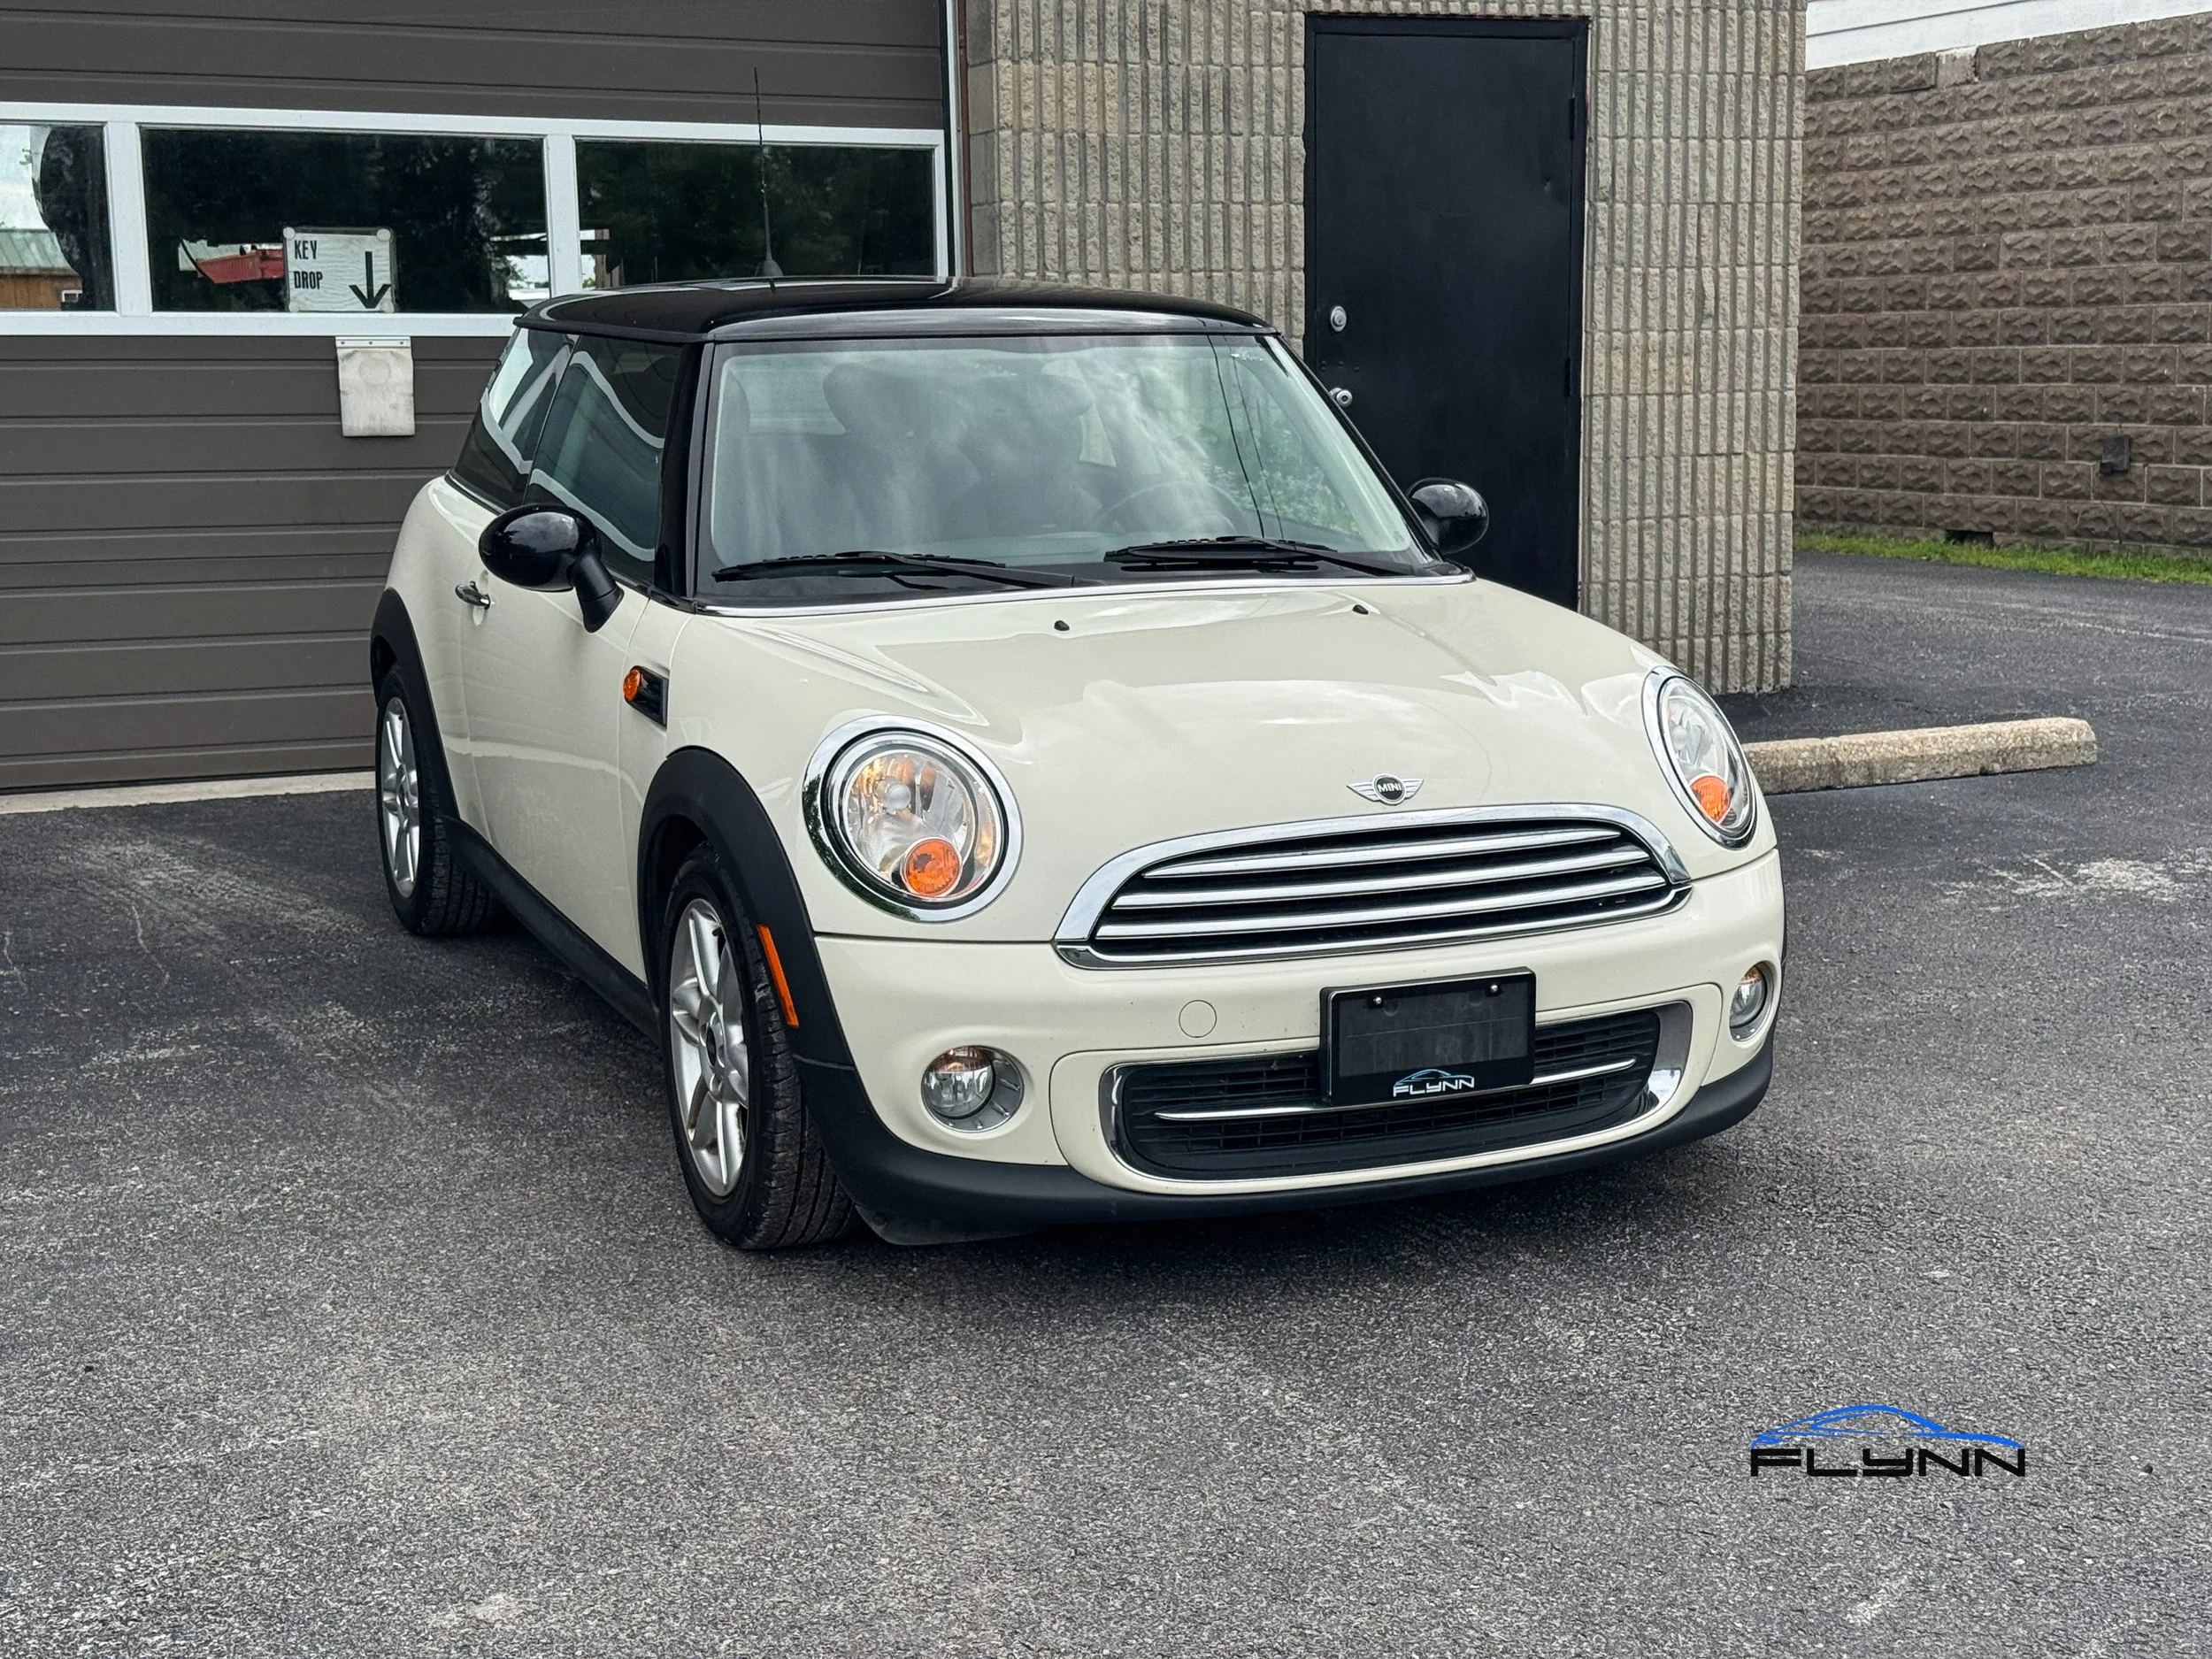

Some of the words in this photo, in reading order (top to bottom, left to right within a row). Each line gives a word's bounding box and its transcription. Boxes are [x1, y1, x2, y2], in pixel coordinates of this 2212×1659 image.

[294, 240, 317, 259] KEY
[294, 271, 323, 289] DROP
[1377, 783, 1402, 793] MINI
[1393, 1077, 1475, 1097] FLYNN
